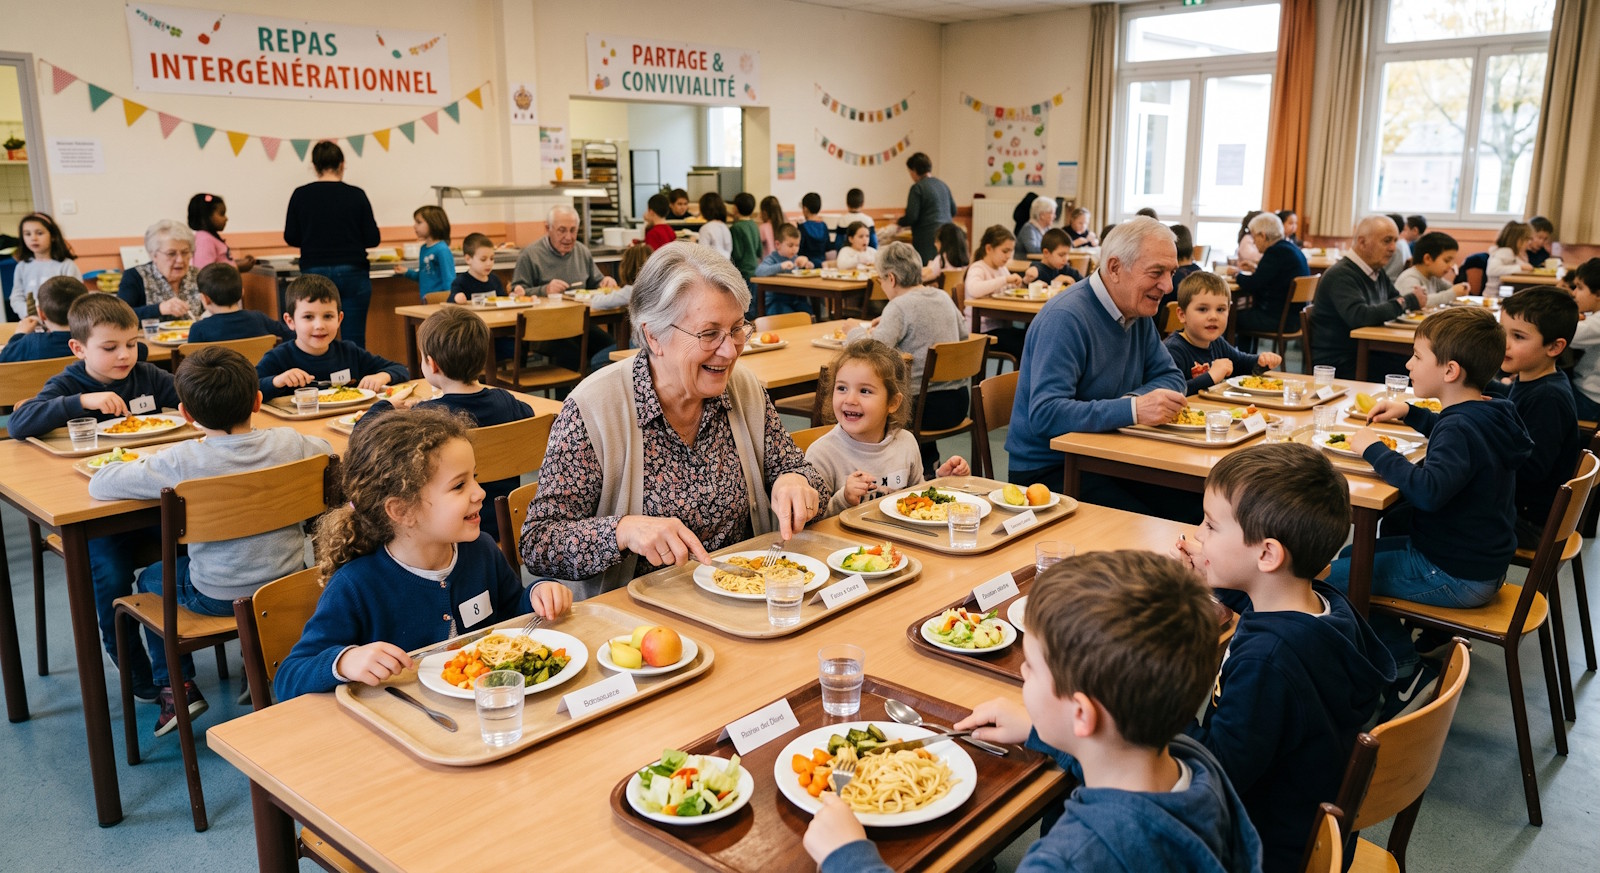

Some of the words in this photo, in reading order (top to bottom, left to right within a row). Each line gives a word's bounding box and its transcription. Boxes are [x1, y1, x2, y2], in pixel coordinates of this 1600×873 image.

[258, 26, 338, 57] REPAS
[632, 44, 708, 71] PARTAGE
[712, 52, 724, 72] &
[150, 53, 438, 94] INTERGÉNÉRATIONNEL
[622, 70, 736, 98] CONVIVIALITÉ
[474, 603, 479, 615] 8
